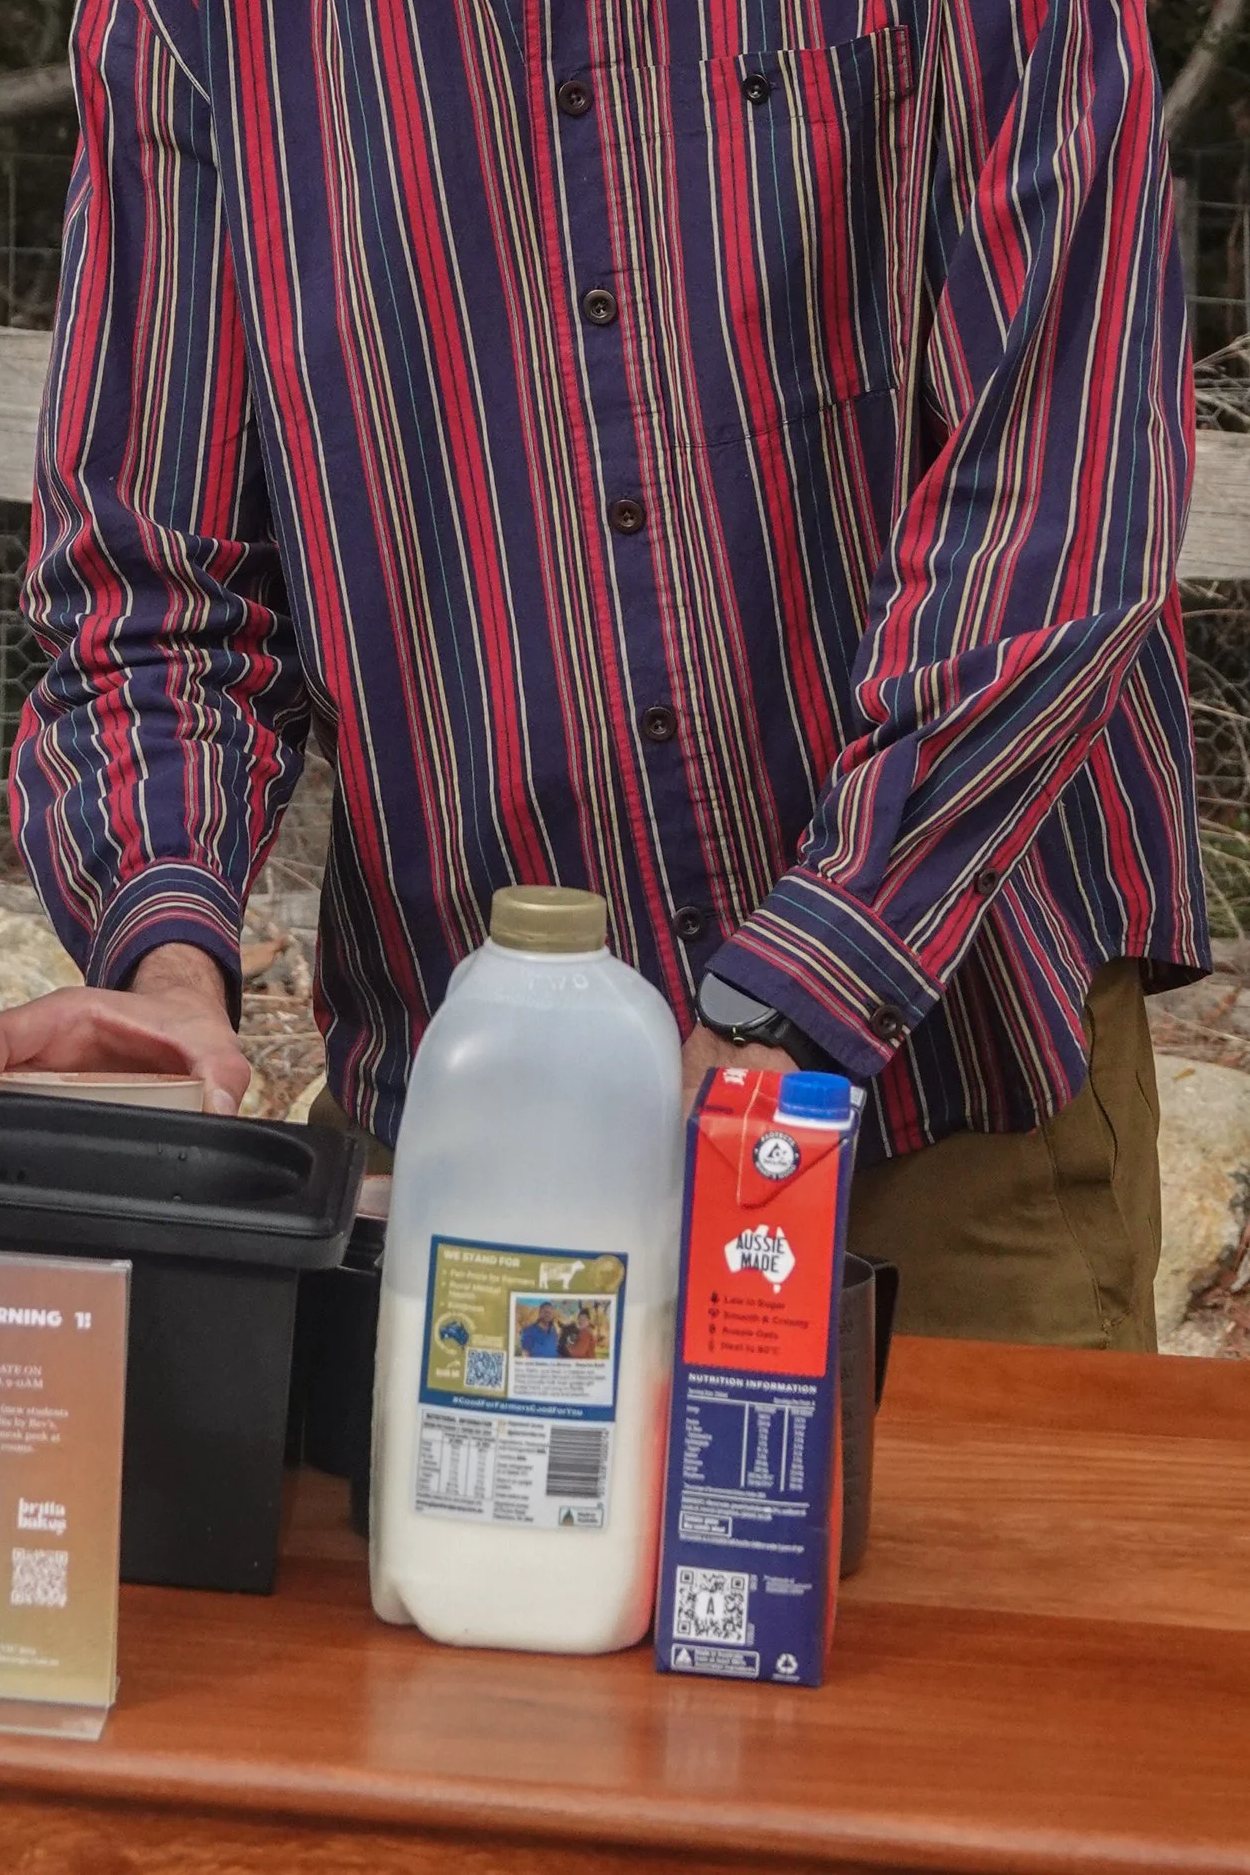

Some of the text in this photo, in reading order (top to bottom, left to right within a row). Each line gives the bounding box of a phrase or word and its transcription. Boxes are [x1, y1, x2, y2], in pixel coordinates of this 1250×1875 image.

[736, 1233, 784, 1254] AUSSIE
[462, 1252, 498, 1265] STAND
[499, 1256, 520, 1267] FOR
[741, 1253, 779, 1273] MADE
[724, 1296, 743, 1305] Low
[758, 1299, 786, 1309] Sugar
[723, 1311, 759, 1322] Smooth
[773, 1316, 808, 1329] Creamy
[24, 1365, 42, 1375] ON
[688, 1373, 817, 1395] NUTRITION INFORMATION
[26, 1406, 69, 1417] students
[452, 1396, 583, 1417] #GoodForFarmersGoodForYou
